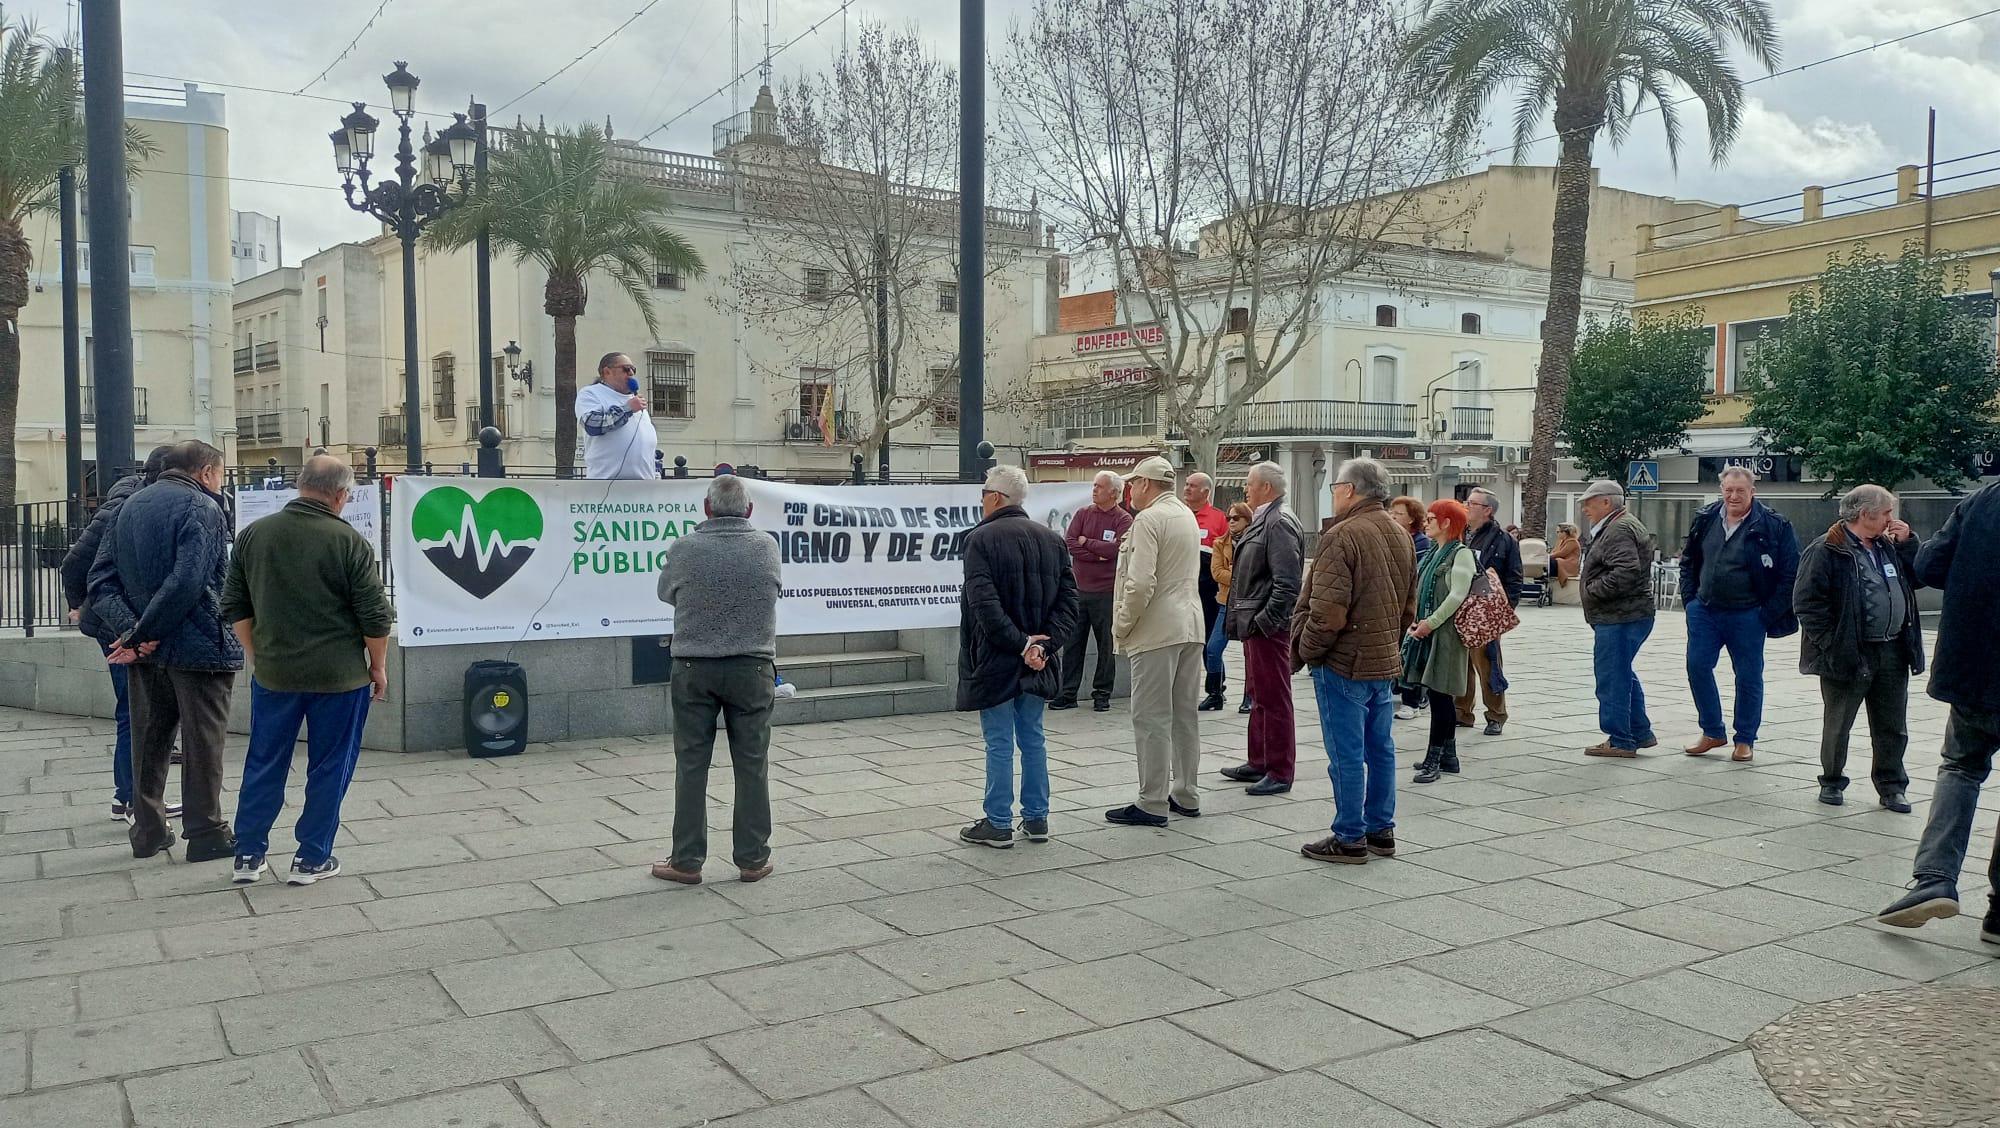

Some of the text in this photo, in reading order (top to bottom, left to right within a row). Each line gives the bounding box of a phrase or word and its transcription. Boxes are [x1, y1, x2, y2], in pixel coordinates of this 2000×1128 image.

[1077, 326, 1164, 351] CONFECCINES
[570, 504, 697, 513] EXTREMADURA POR LA
[784, 502, 807, 514] POR
[787, 514, 803, 526] UN
[813, 504, 984, 529] CENTRO DE SALU
[862, 532, 881, 563] Y
[887, 532, 924, 562] DE
[930, 532, 965, 561] CA
[573, 544, 667, 574] PÚBLIC
[796, 588, 812, 598] LOS
[814, 587, 853, 598] PUEBLOS
[854, 586, 893, 596] TENEMOS
[894, 585, 930, 595] DERECHO
[932, 585, 939, 593] A
[940, 584, 958, 593] UNA
[826, 596, 961, 609] UNIVERSAL, GRATUITA Y DE CALI
